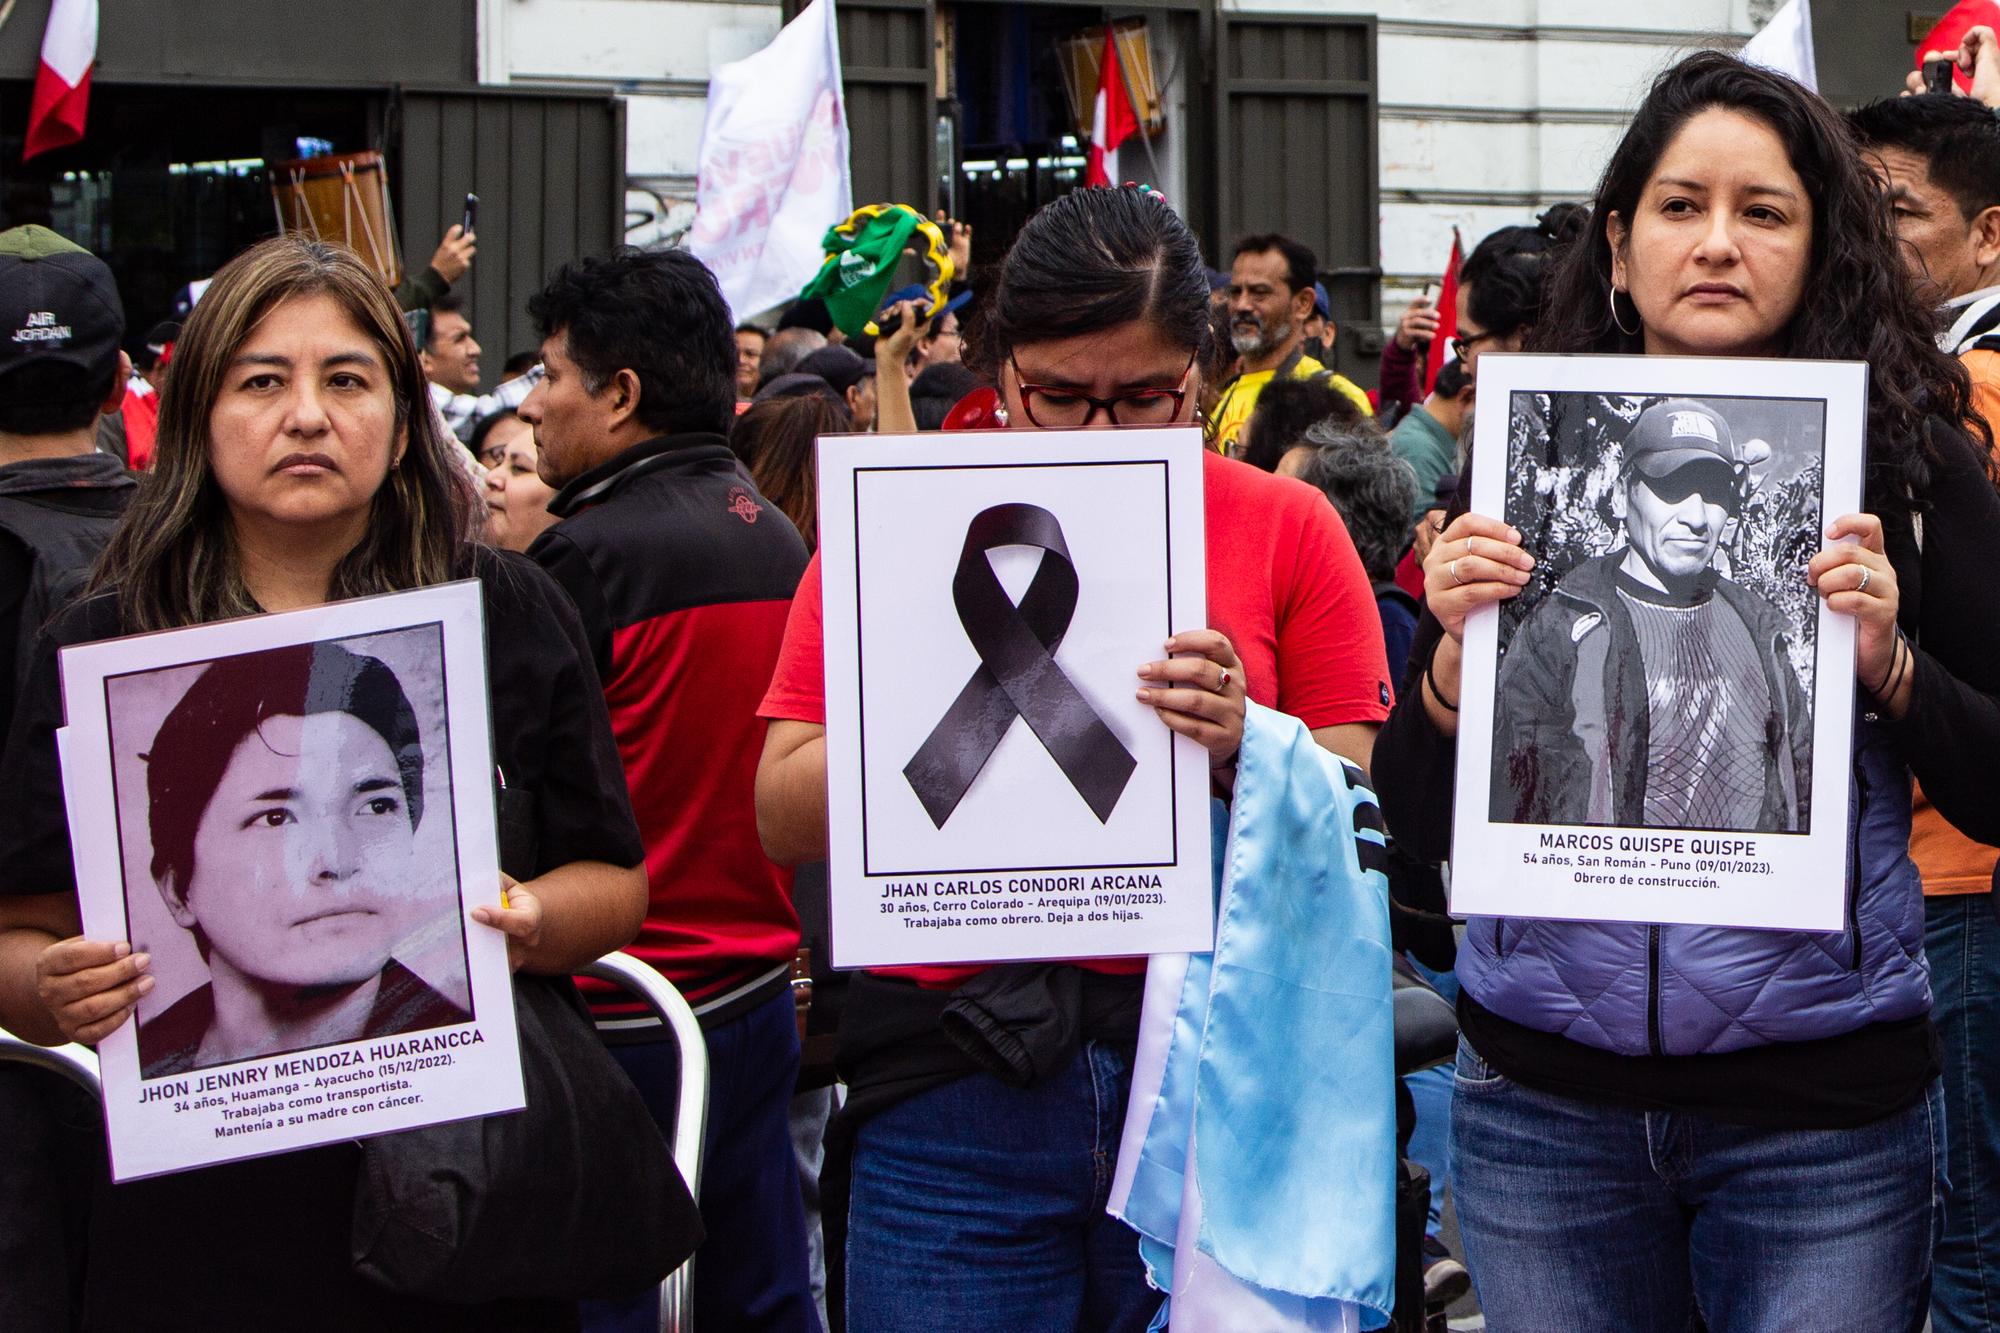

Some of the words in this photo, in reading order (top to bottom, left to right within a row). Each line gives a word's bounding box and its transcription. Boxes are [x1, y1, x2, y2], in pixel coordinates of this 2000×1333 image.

[26, 311, 56, 327] AIR
[11, 326, 72, 342] JORDAN
[1540, 833, 1613, 850] MARCOS
[1619, 836, 1684, 854] QUISPE
[1690, 839, 1756, 856] QUISPE
[1523, 853, 1537, 864] 54
[1541, 854, 1573, 867] años,
[1577, 855, 1600, 867] San
[1604, 856, 1646, 868] Román
[1660, 858, 1691, 871] Puno
[1695, 859, 1774, 875] (09/01/2023).
[881, 882, 928, 898] JHAN
[934, 879, 1002, 896] CARLOS
[1008, 877, 1085, 893] CONDORI
[1090, 874, 1163, 890] ARCANA
[1574, 872, 1616, 884] Obrero
[1619, 874, 1634, 885] de
[1638, 876, 1720, 889] construcción.
[880, 902, 894, 913] 30
[898, 901, 930, 913] años,
[933, 901, 967, 911] Cerro
[970, 898, 1024, 910] Colorado
[1037, 896, 1090, 909] Arequipa
[1094, 893, 1166, 907] (19/01/2023).
[903, 915, 962, 929] Trabajaba
[965, 917, 998, 926] como
[1001, 914, 1044, 925] obrero.
[1047, 912, 1073, 924] Deja
[1077, 913, 1084, 922] a
[1088, 911, 1109, 921] dos
[1112, 910, 1144, 923] hijas.
[139, 1081, 190, 1104] JHON
[195, 1066, 269, 1093] JENNRY
[275, 1050, 364, 1079] MENDOZA
[370, 1029, 484, 1062] HUARANCCA
[174, 1101, 190, 1113] 34
[194, 1093, 228, 1111] años,
[231, 1081, 300, 1103] Huamanga
[314, 1068, 374, 1088] Ayacucho
[378, 1054, 456, 1078] (15/12/2022).
[222, 1099, 285, 1120] Trabajaba
[288, 1095, 322, 1109] como
[326, 1079, 413, 1102] transportista.
[214, 1118, 273, 1138] Mantenía
[277, 1119, 284, 1127] a
[288, 1114, 304, 1125] su
[307, 1106, 348, 1122] madre
[352, 1102, 374, 1114] con
[378, 1094, 424, 1109] cáncer.
